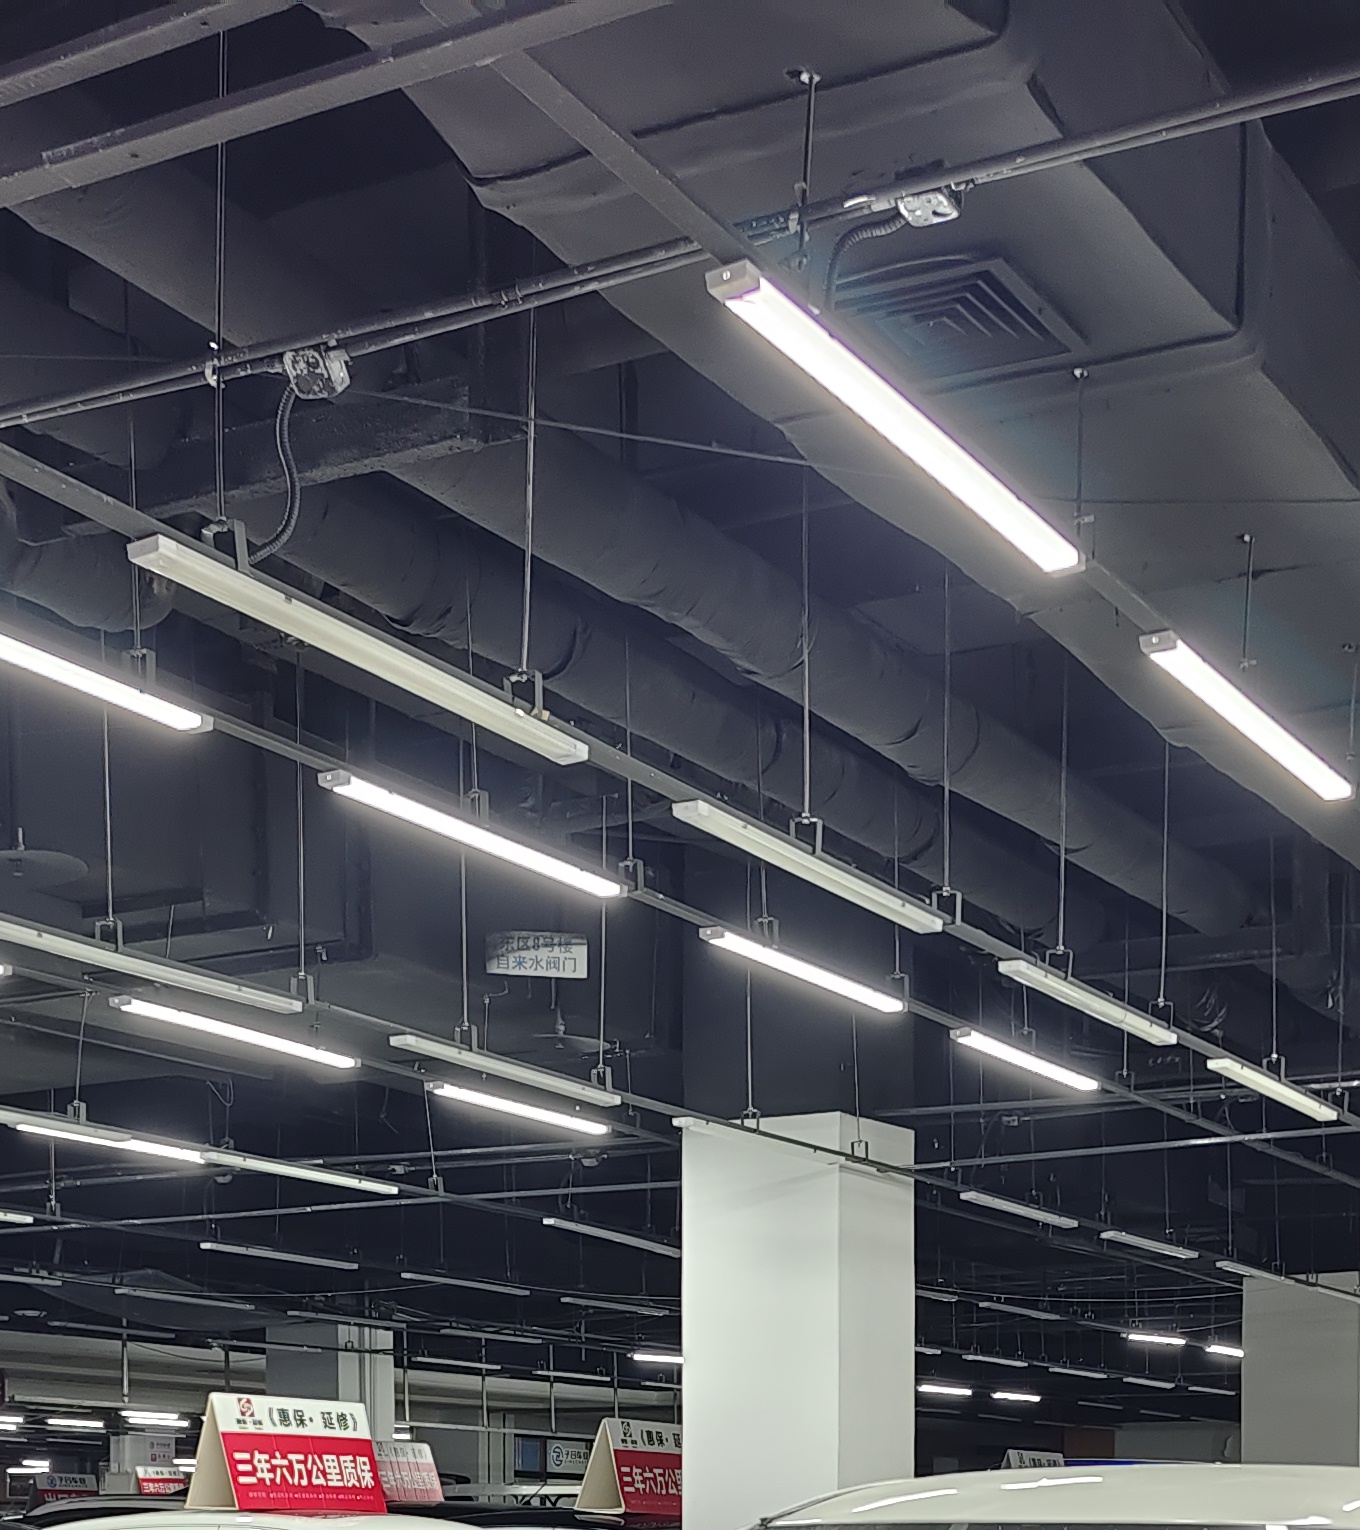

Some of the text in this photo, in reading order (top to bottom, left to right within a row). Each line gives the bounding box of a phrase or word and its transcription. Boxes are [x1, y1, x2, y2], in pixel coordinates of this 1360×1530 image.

[496, 954, 577, 973] 自来水阀门
[233, 1450, 375, 1489] 三年六万公里质保
